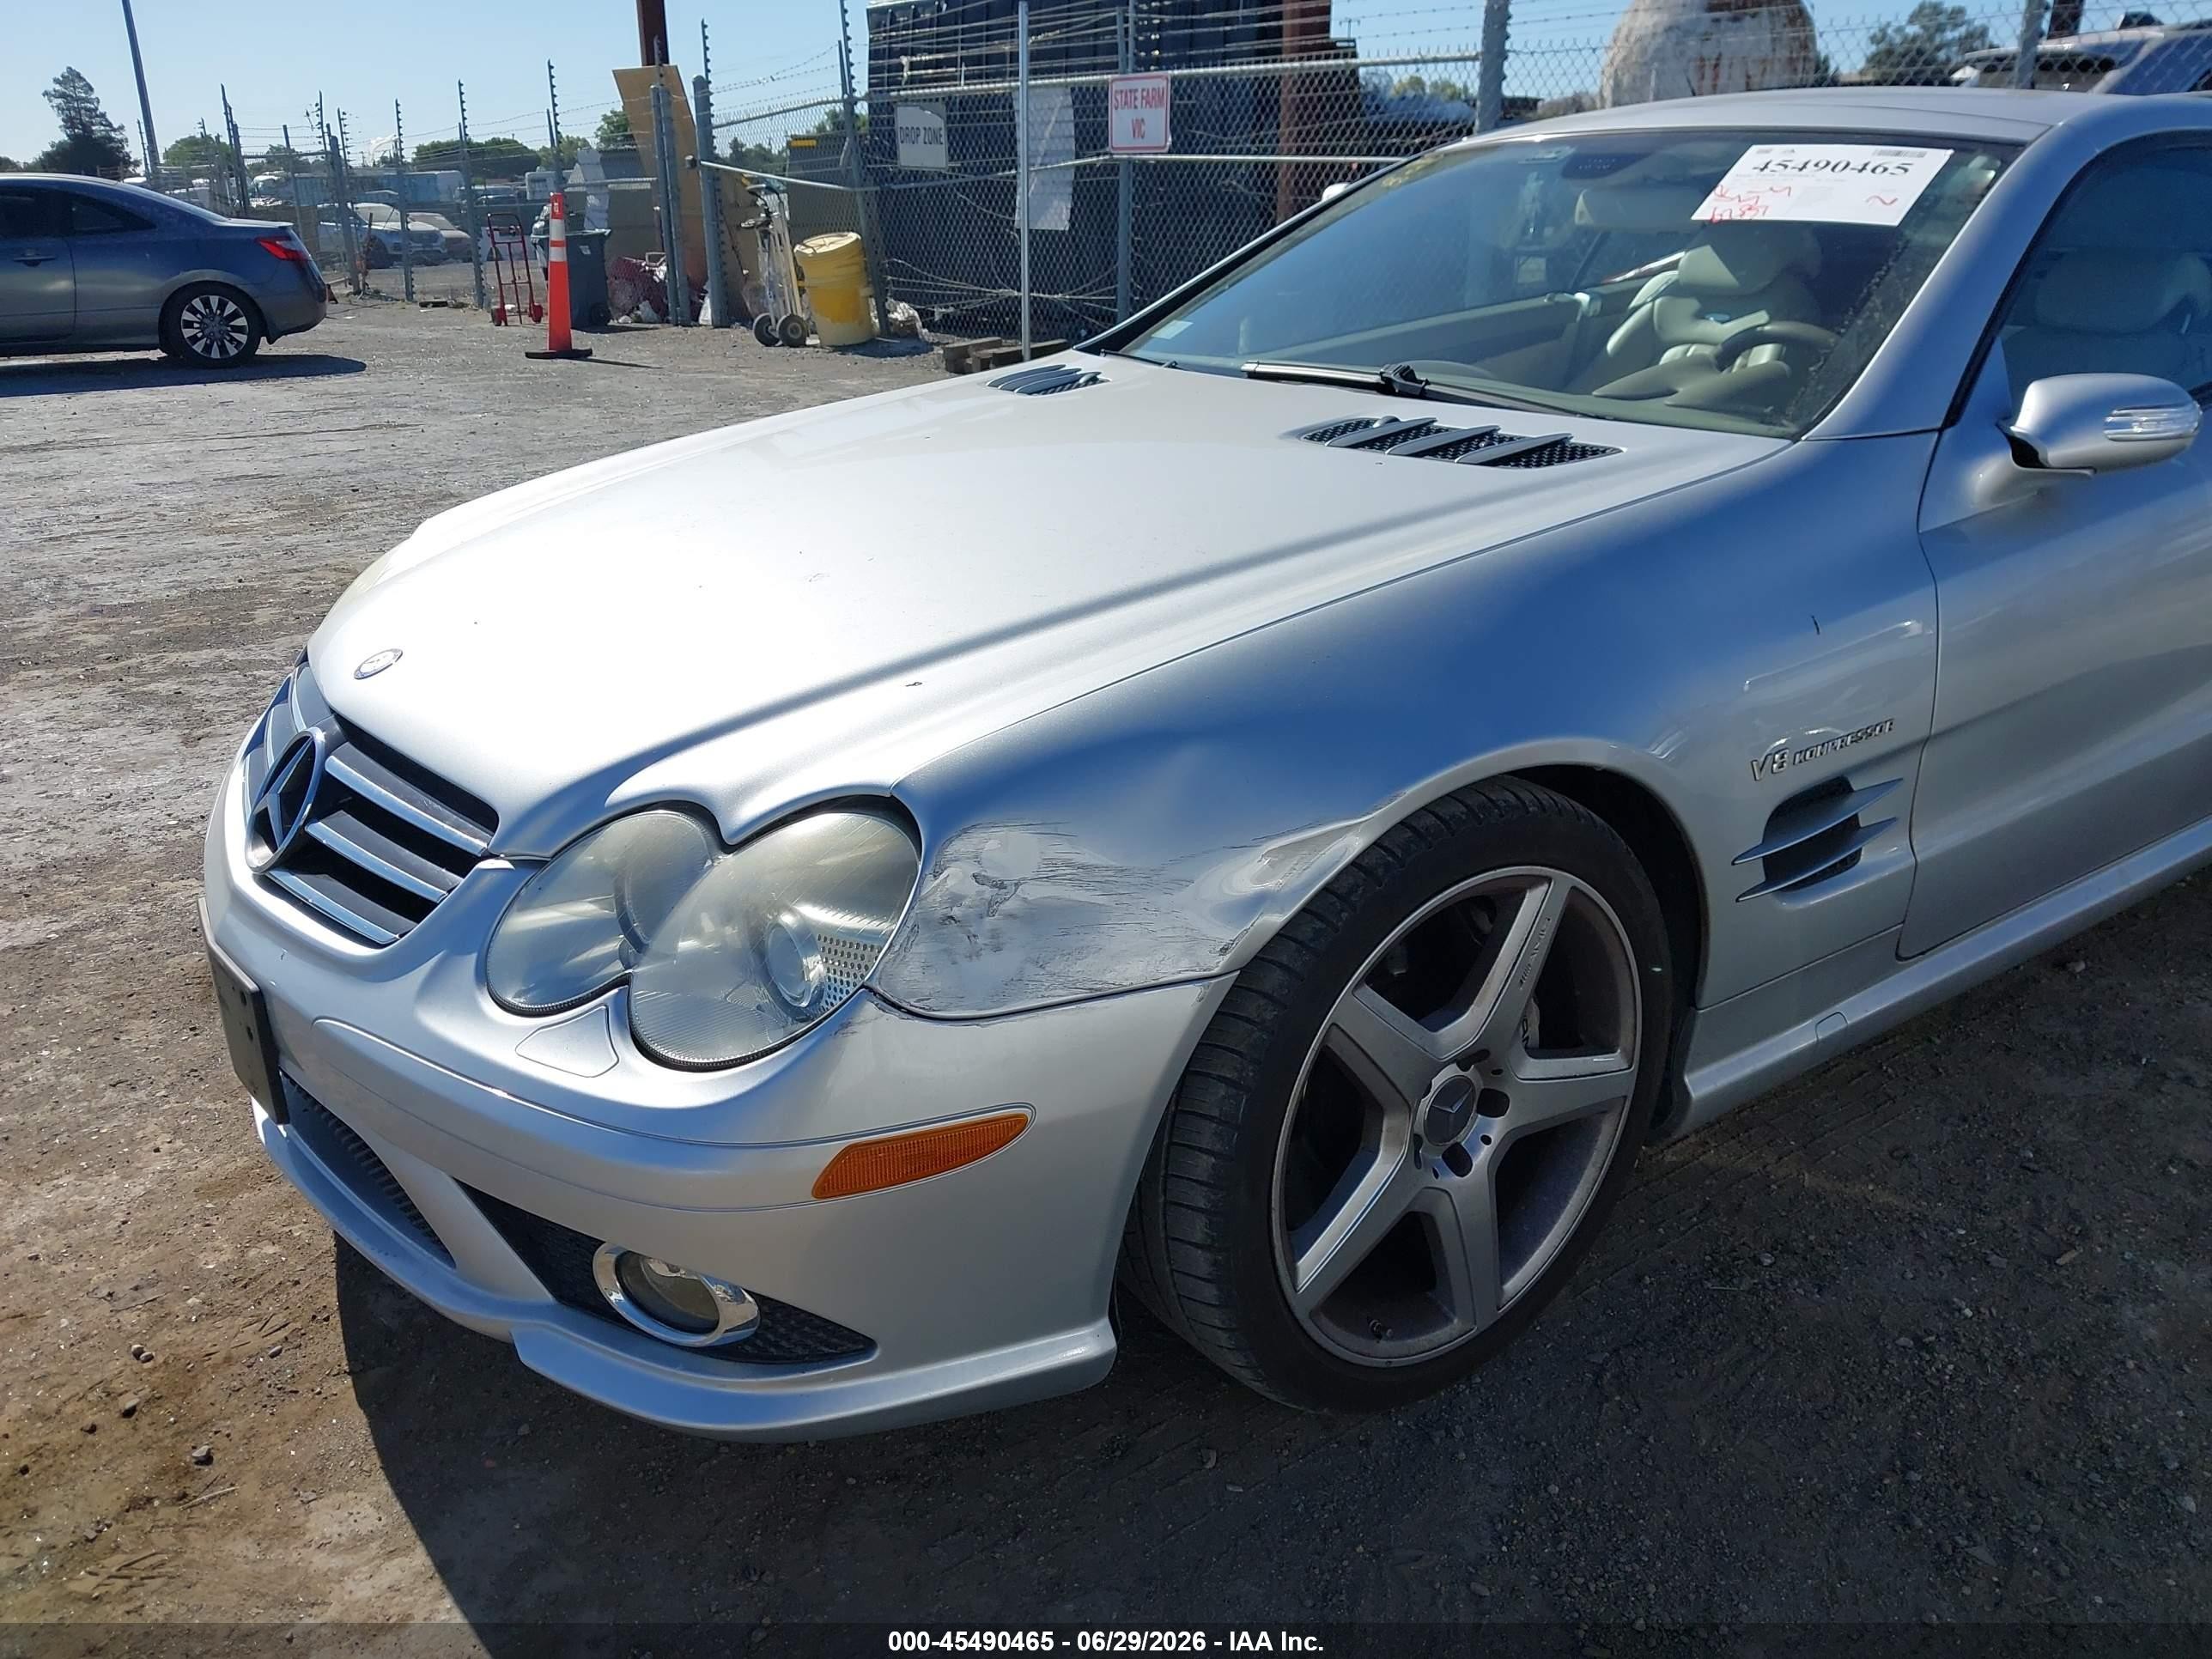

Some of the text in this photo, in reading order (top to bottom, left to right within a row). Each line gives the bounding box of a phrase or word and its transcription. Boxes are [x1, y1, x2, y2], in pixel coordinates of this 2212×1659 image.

[1114, 87, 1165, 111] STATE FARM
[899, 126, 944, 145] DROP ZONE
[1131, 117, 1146, 140] VIC
[1751, 158, 1915, 176] 45490465
[1750, 718, 1895, 781] V8 KOMPRESSOR
